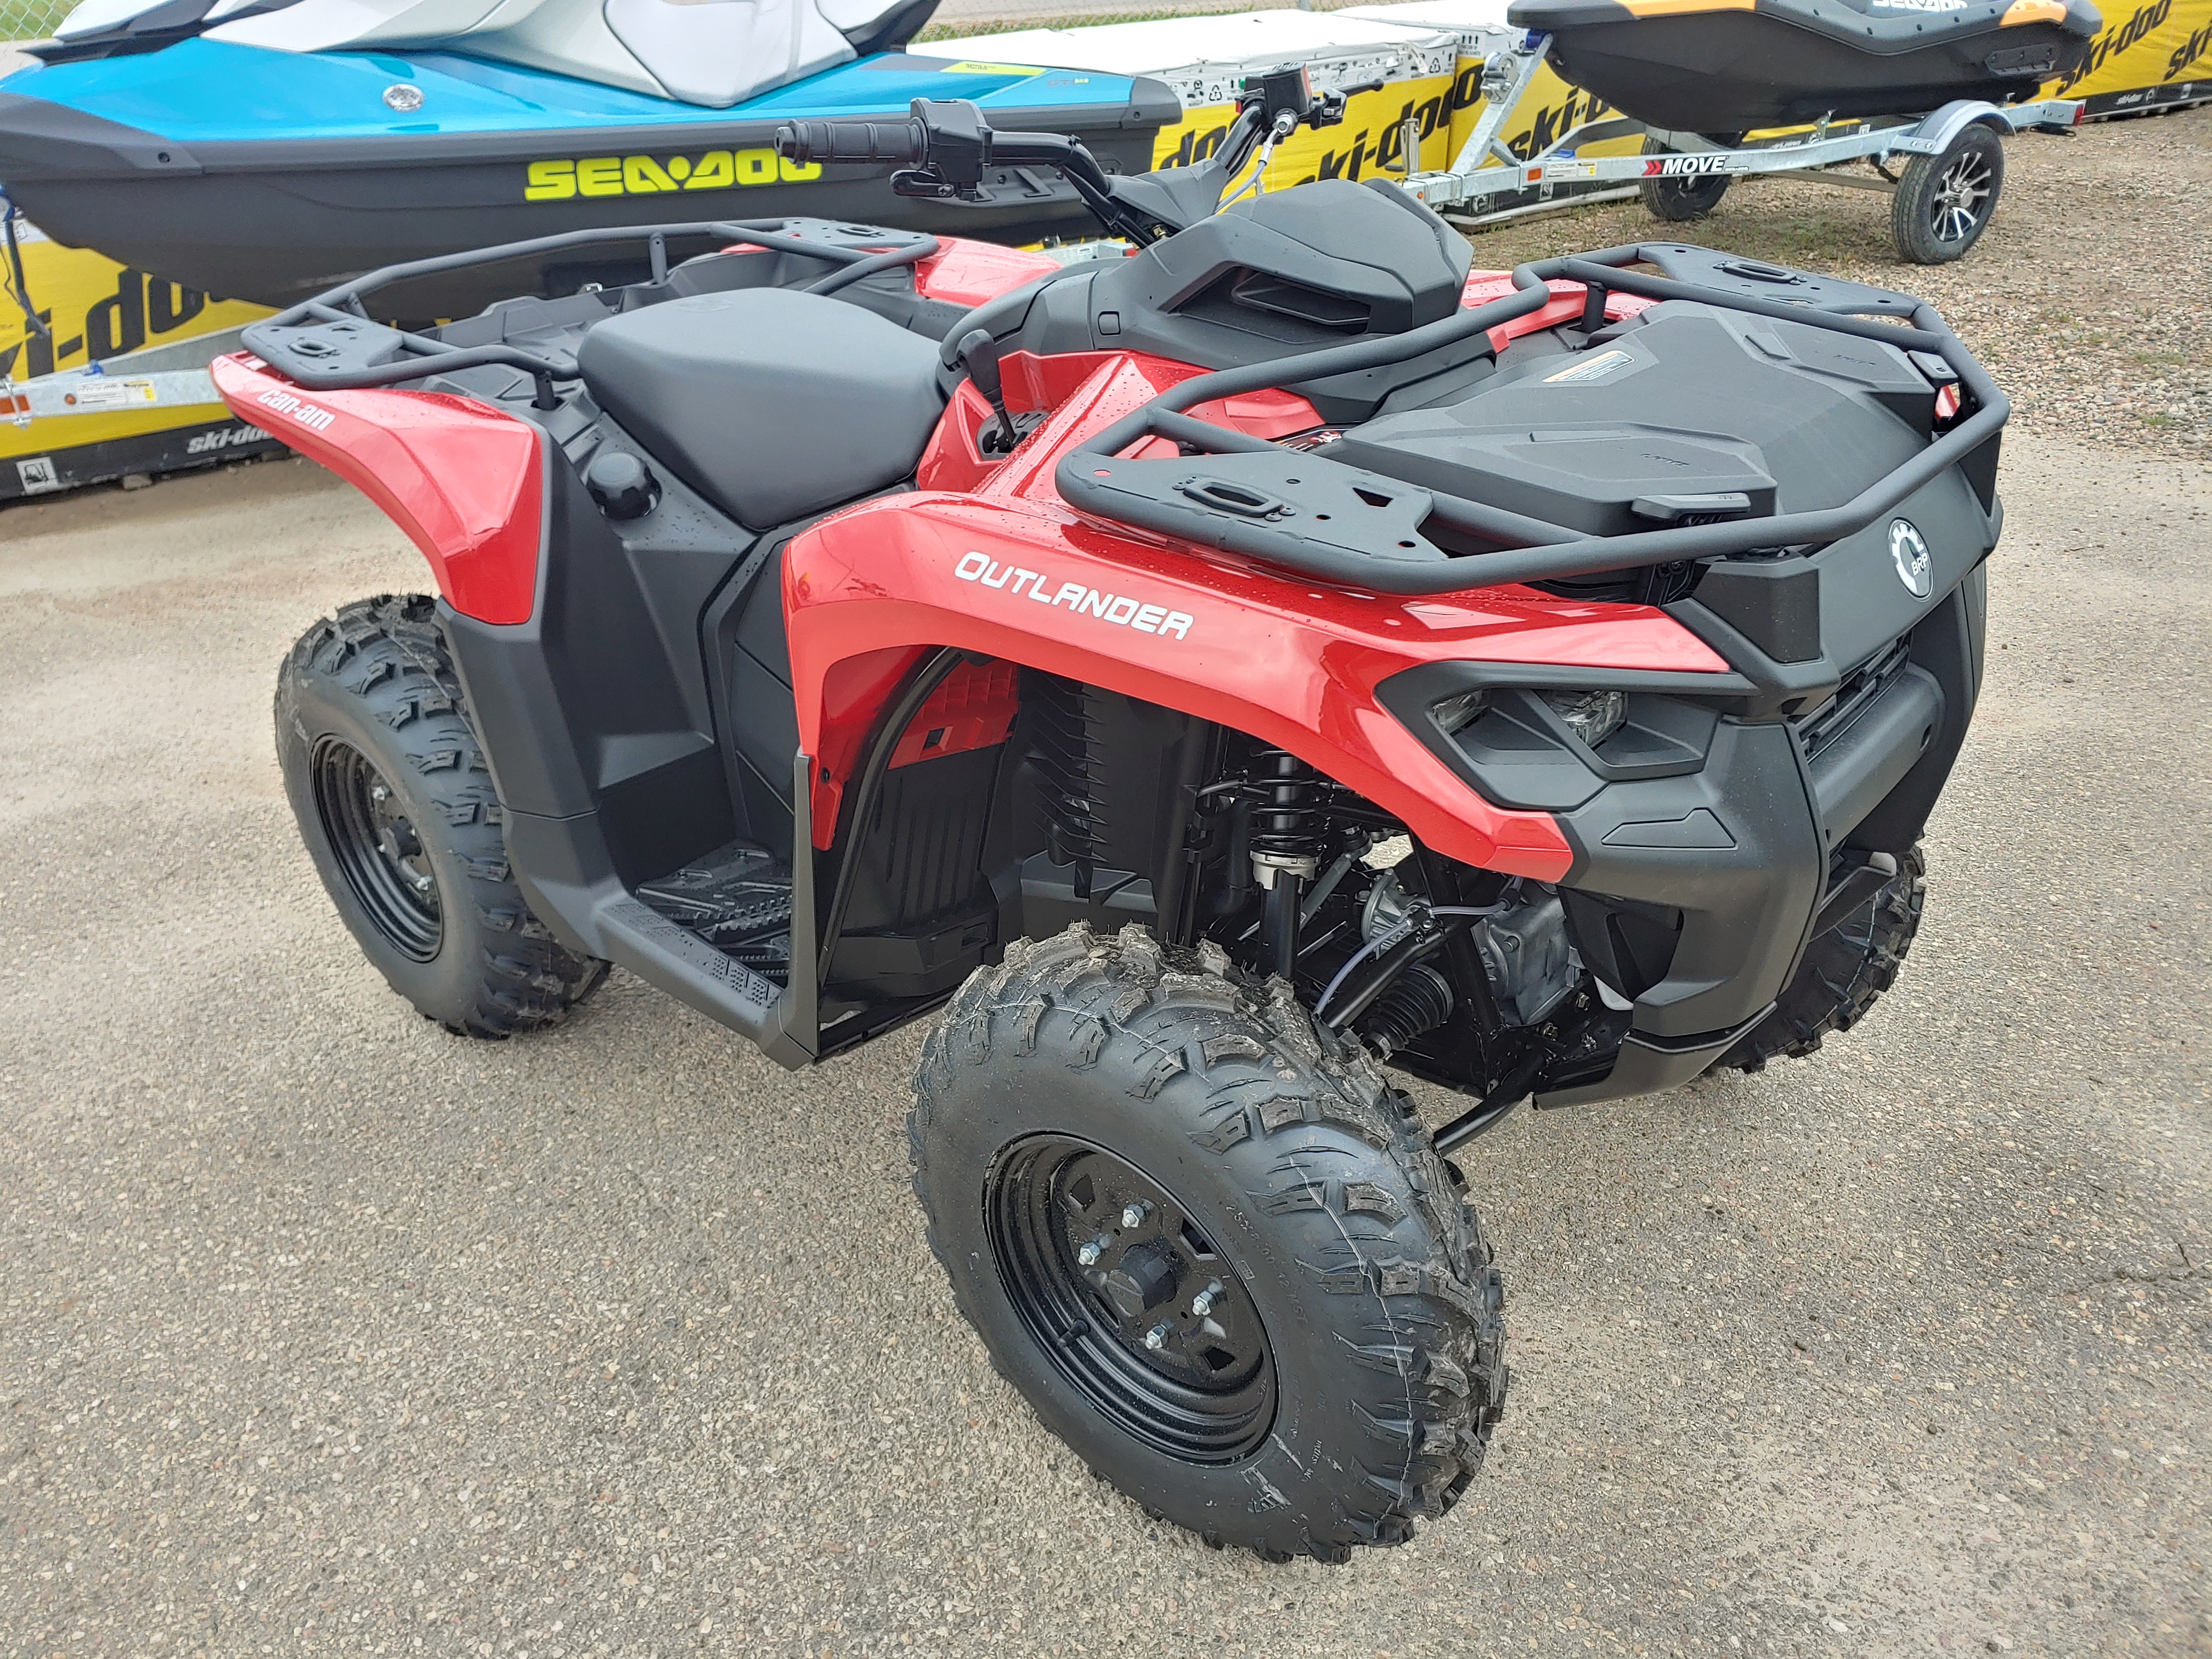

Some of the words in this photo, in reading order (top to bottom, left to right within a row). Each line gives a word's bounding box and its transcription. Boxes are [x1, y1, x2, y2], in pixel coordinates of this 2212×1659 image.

[1290, 88, 1453, 183] ki-do
[1662, 156, 1726, 174] MOVE
[257, 388, 336, 431] can-am
[1911, 552, 1928, 576] BRP
[954, 551, 1194, 641] OUTLANDER
